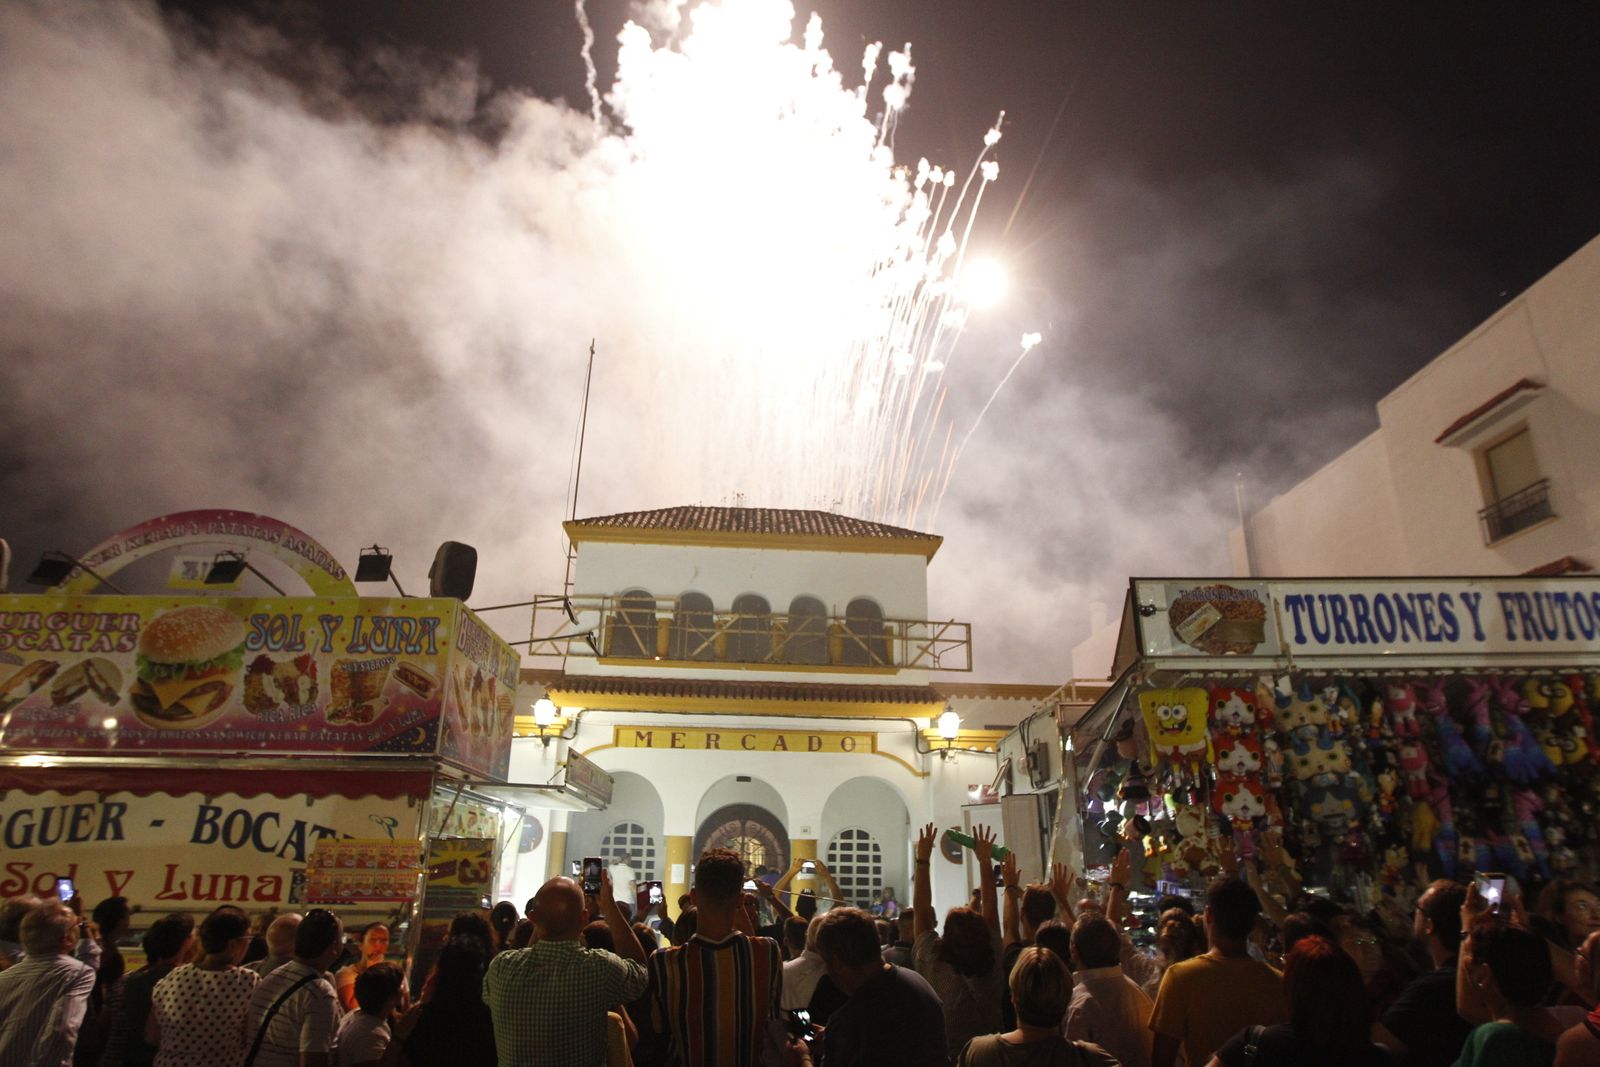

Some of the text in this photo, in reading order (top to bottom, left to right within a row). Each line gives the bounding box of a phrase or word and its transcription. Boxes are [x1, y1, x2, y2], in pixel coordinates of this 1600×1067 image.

[205, 521, 281, 544] PATATAS
[281, 535, 348, 582] ASADAS
[245, 613, 305, 652] SOL
[318, 614, 344, 655] Y
[346, 615, 440, 655] LUNA
[1285, 593, 1460, 645] TURRONES
[1459, 591, 1486, 642] Y
[634, 730, 857, 752] MERCADO
[0, 802, 127, 849] GUER
[190, 805, 355, 863] BOCA
[155, 863, 283, 902] Luna
